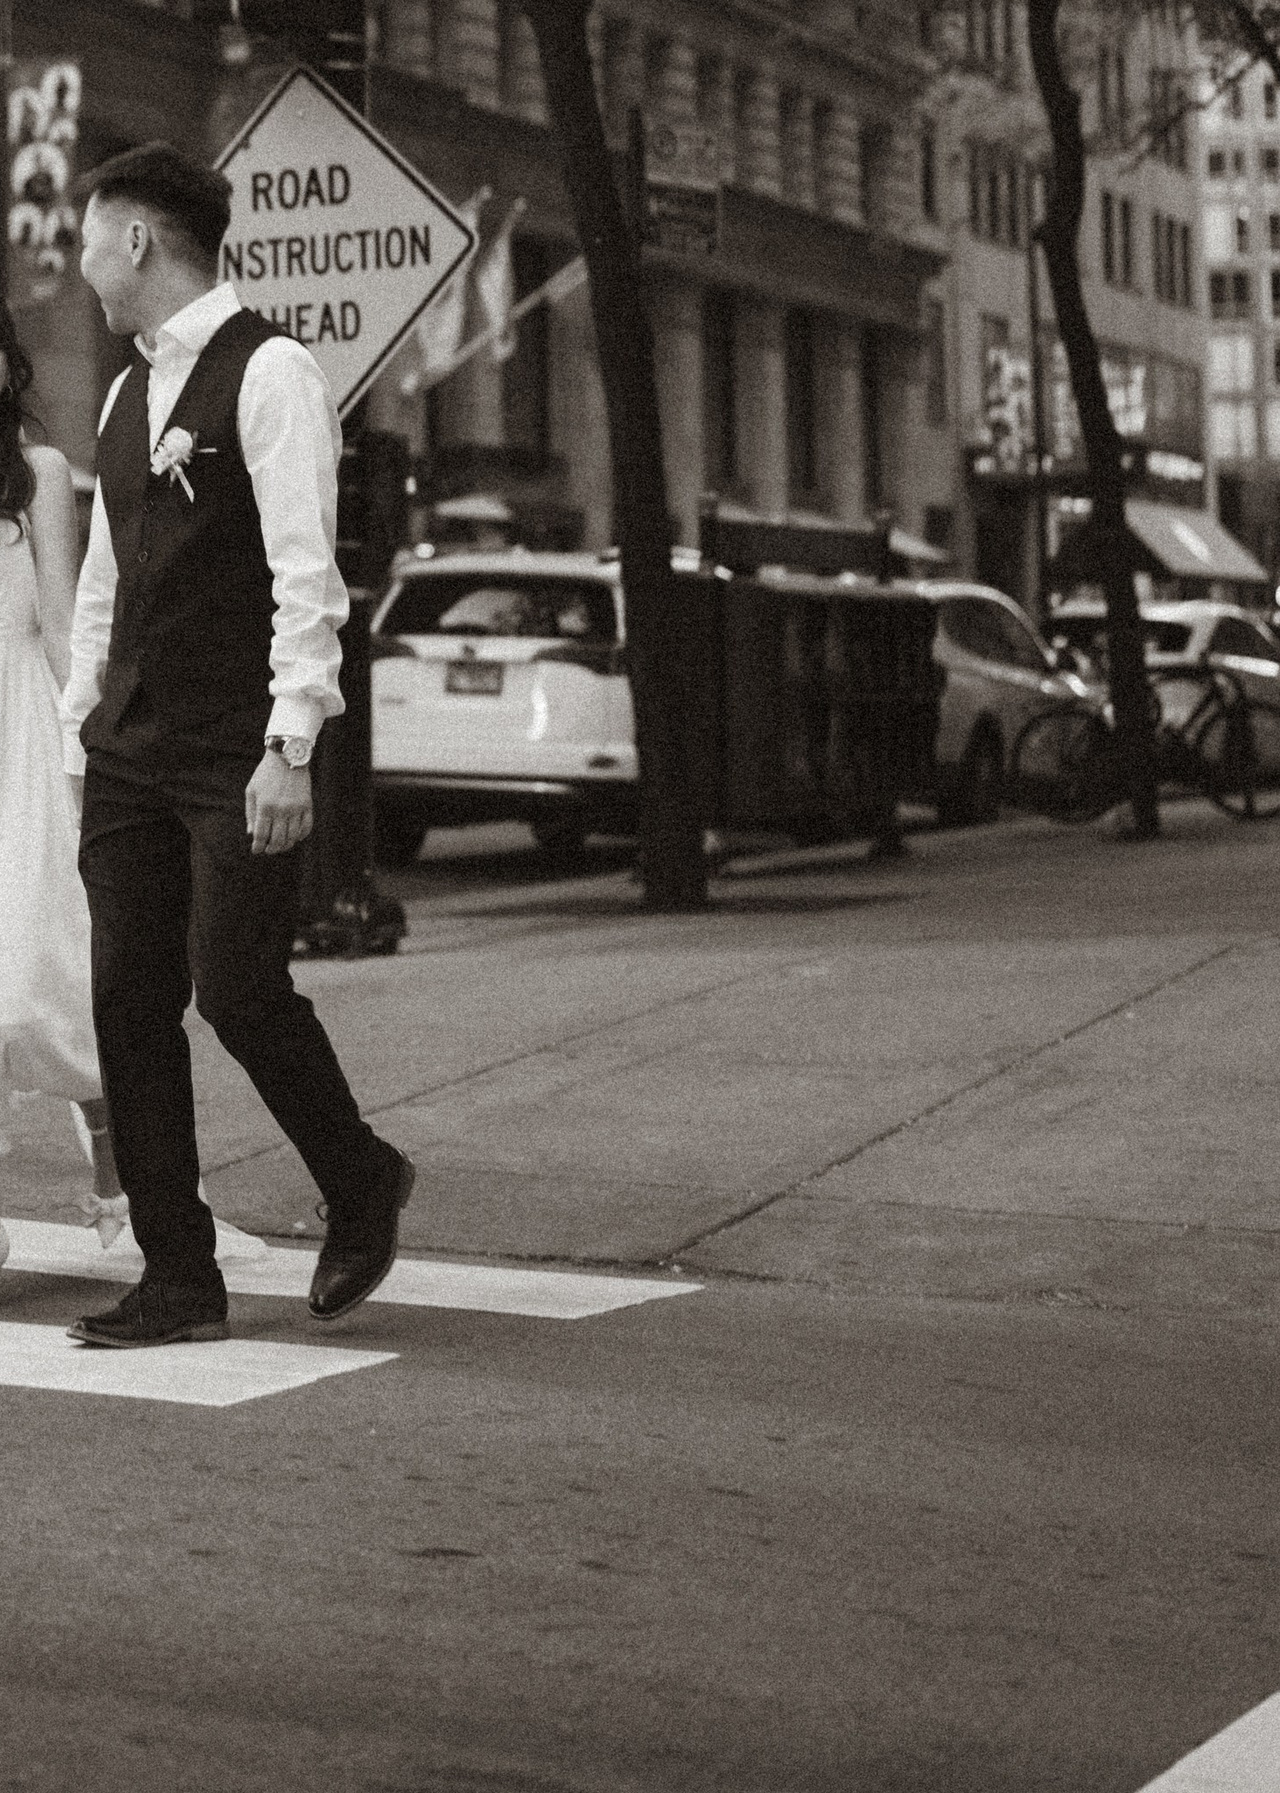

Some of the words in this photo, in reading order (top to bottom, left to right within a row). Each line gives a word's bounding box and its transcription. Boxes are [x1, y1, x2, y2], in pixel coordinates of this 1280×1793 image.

[251, 164, 351, 210] ROAD
[223, 224, 431, 281] NSTRUCTION
[254, 299, 361, 344] HEAD
